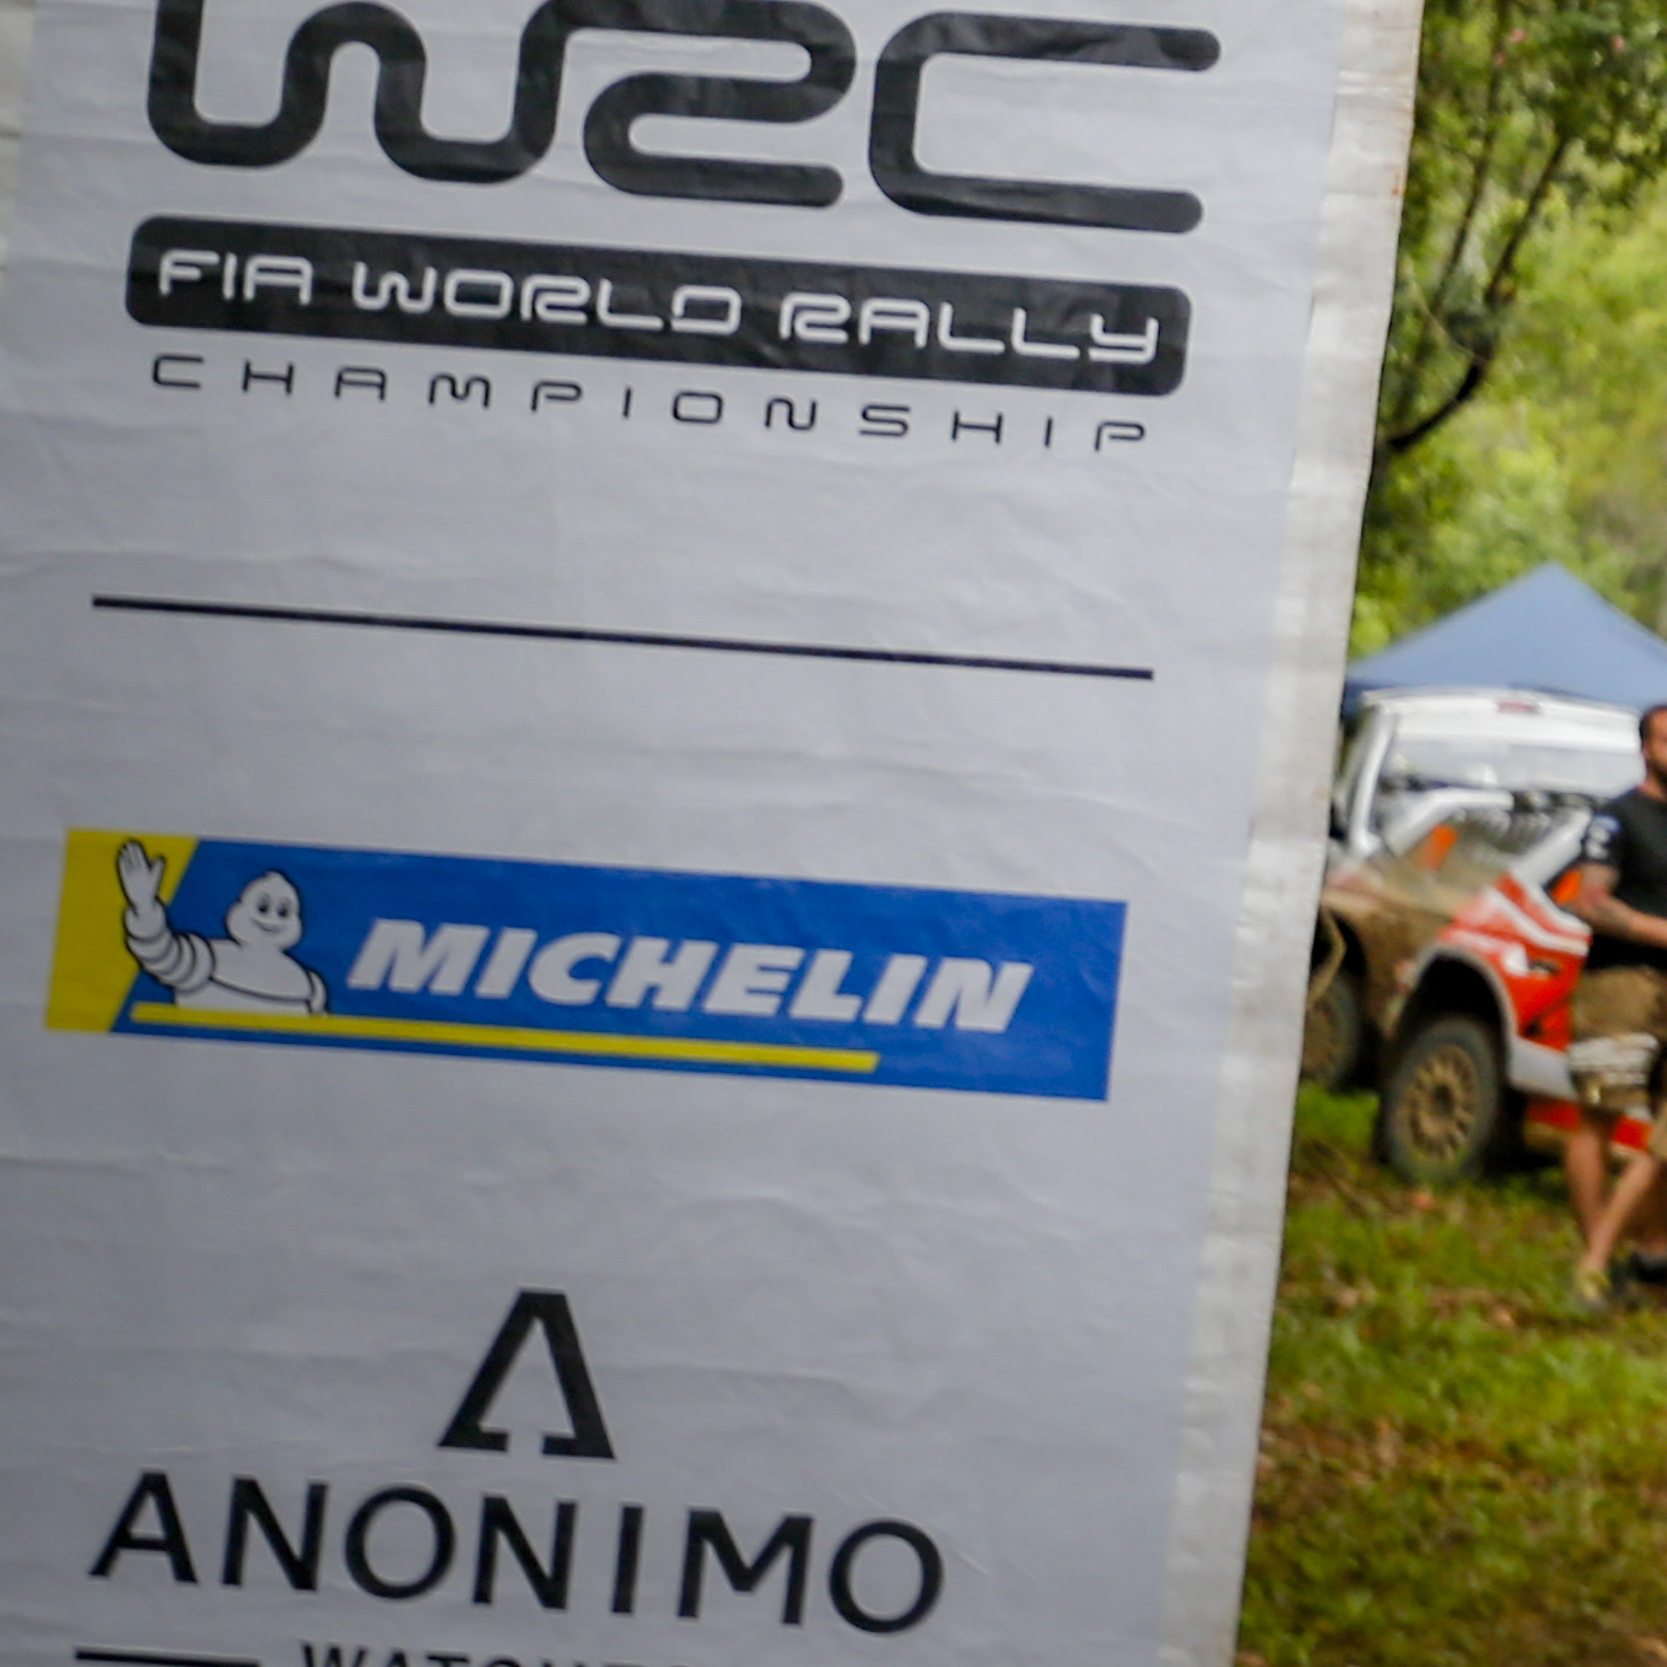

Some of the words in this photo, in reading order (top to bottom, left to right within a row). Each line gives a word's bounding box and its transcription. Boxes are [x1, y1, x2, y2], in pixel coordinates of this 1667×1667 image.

[158, 248, 314, 308] FIA
[352, 259, 743, 336] WORLD
[778, 291, 1161, 366] RALLY
[151, 352, 1148, 452] CHAMPIONSHIP
[347, 918, 1034, 1034] MICHELIN
[88, 1471, 945, 1636] ANONIMO
